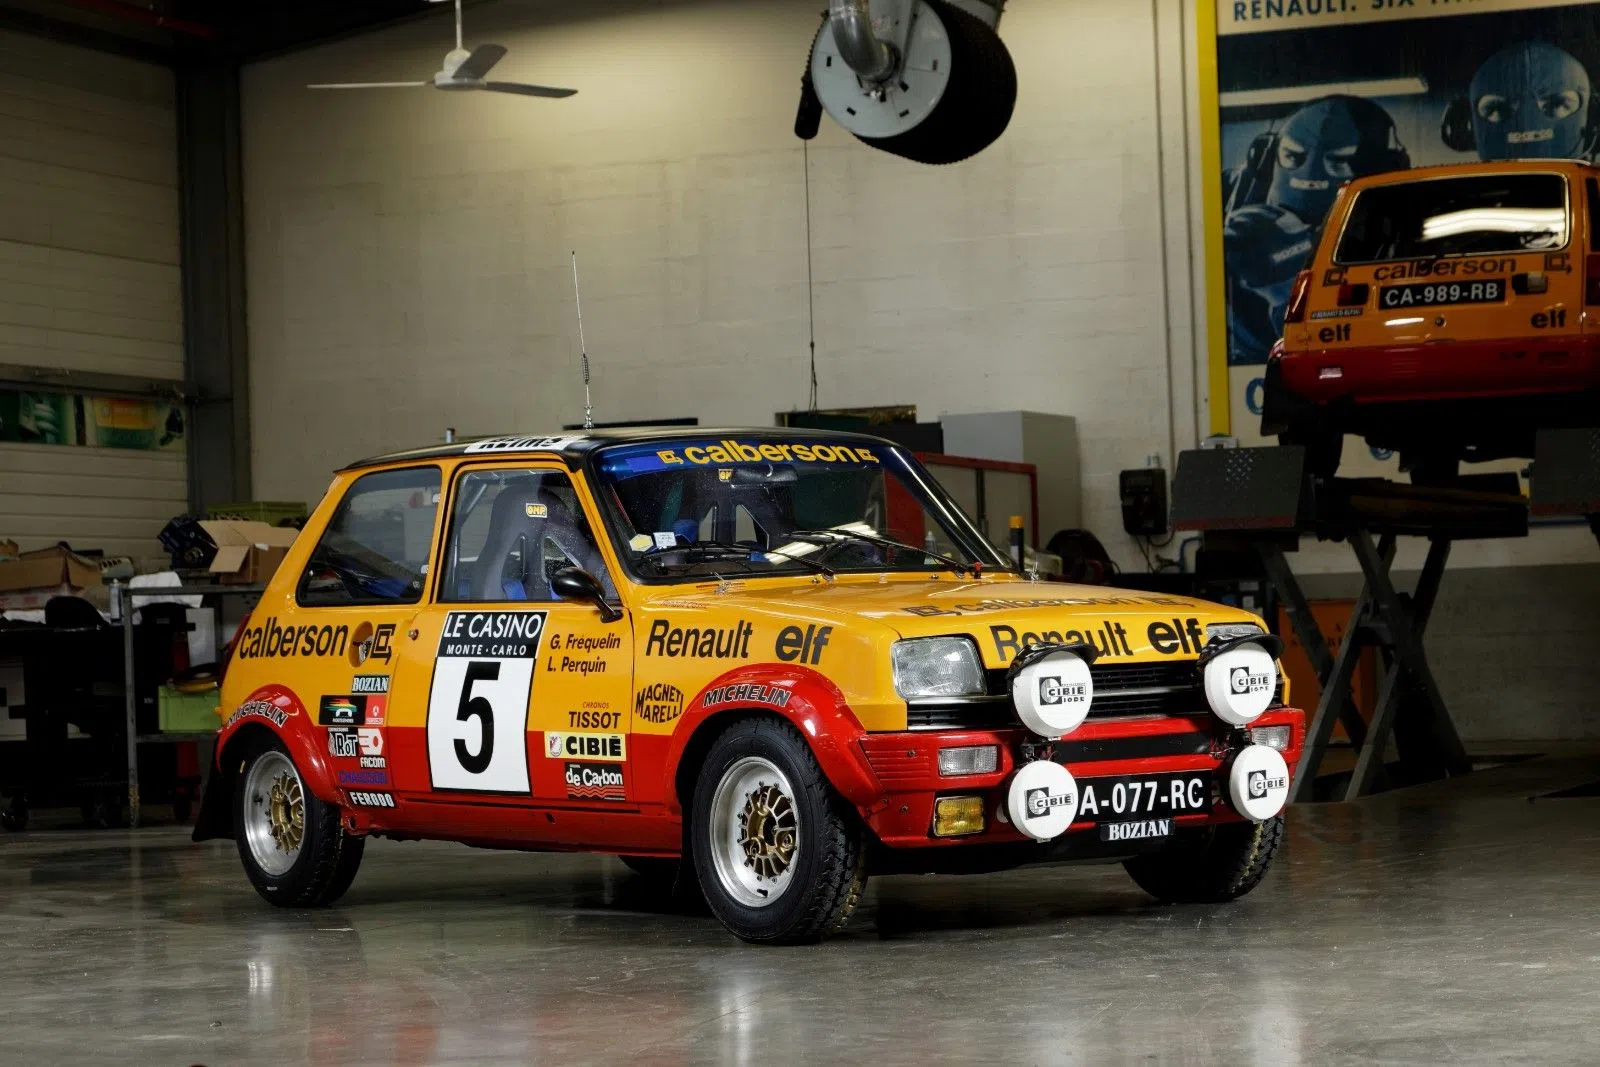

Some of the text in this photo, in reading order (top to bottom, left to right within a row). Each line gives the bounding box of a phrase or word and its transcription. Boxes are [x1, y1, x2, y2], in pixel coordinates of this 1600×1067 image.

[1373, 257, 1516, 281] calberson
[1385, 283, 1498, 305] CA-989-RB
[1531, 310, 1566, 328] elf
[1319, 323, 1351, 342] elf
[684, 440, 862, 464] calberson
[443, 614, 542, 638] LE CASINO
[1147, 617, 1203, 655] elf
[239, 616, 348, 659] calberson
[550, 634, 561, 650] G.
[646, 619, 753, 658] Renault
[775, 624, 834, 665] elf
[547, 656, 607, 677] L. Perquin
[352, 676, 389, 692] BOZIAN
[636, 682, 684, 704] MAGNETI
[582, 701, 609, 709] CHRONOS
[702, 683, 791, 708] MICHELIN
[226, 700, 288, 728] MICHELIN
[453, 661, 501, 774] 5
[568, 711, 621, 728] TISSOT
[635, 701, 684, 723] MARELLI
[360, 757, 385, 768] FACOM
[566, 768, 623, 787] de Carbon
[350, 791, 394, 808] FERODO
[1109, 820, 1170, 841] BOZIAN
